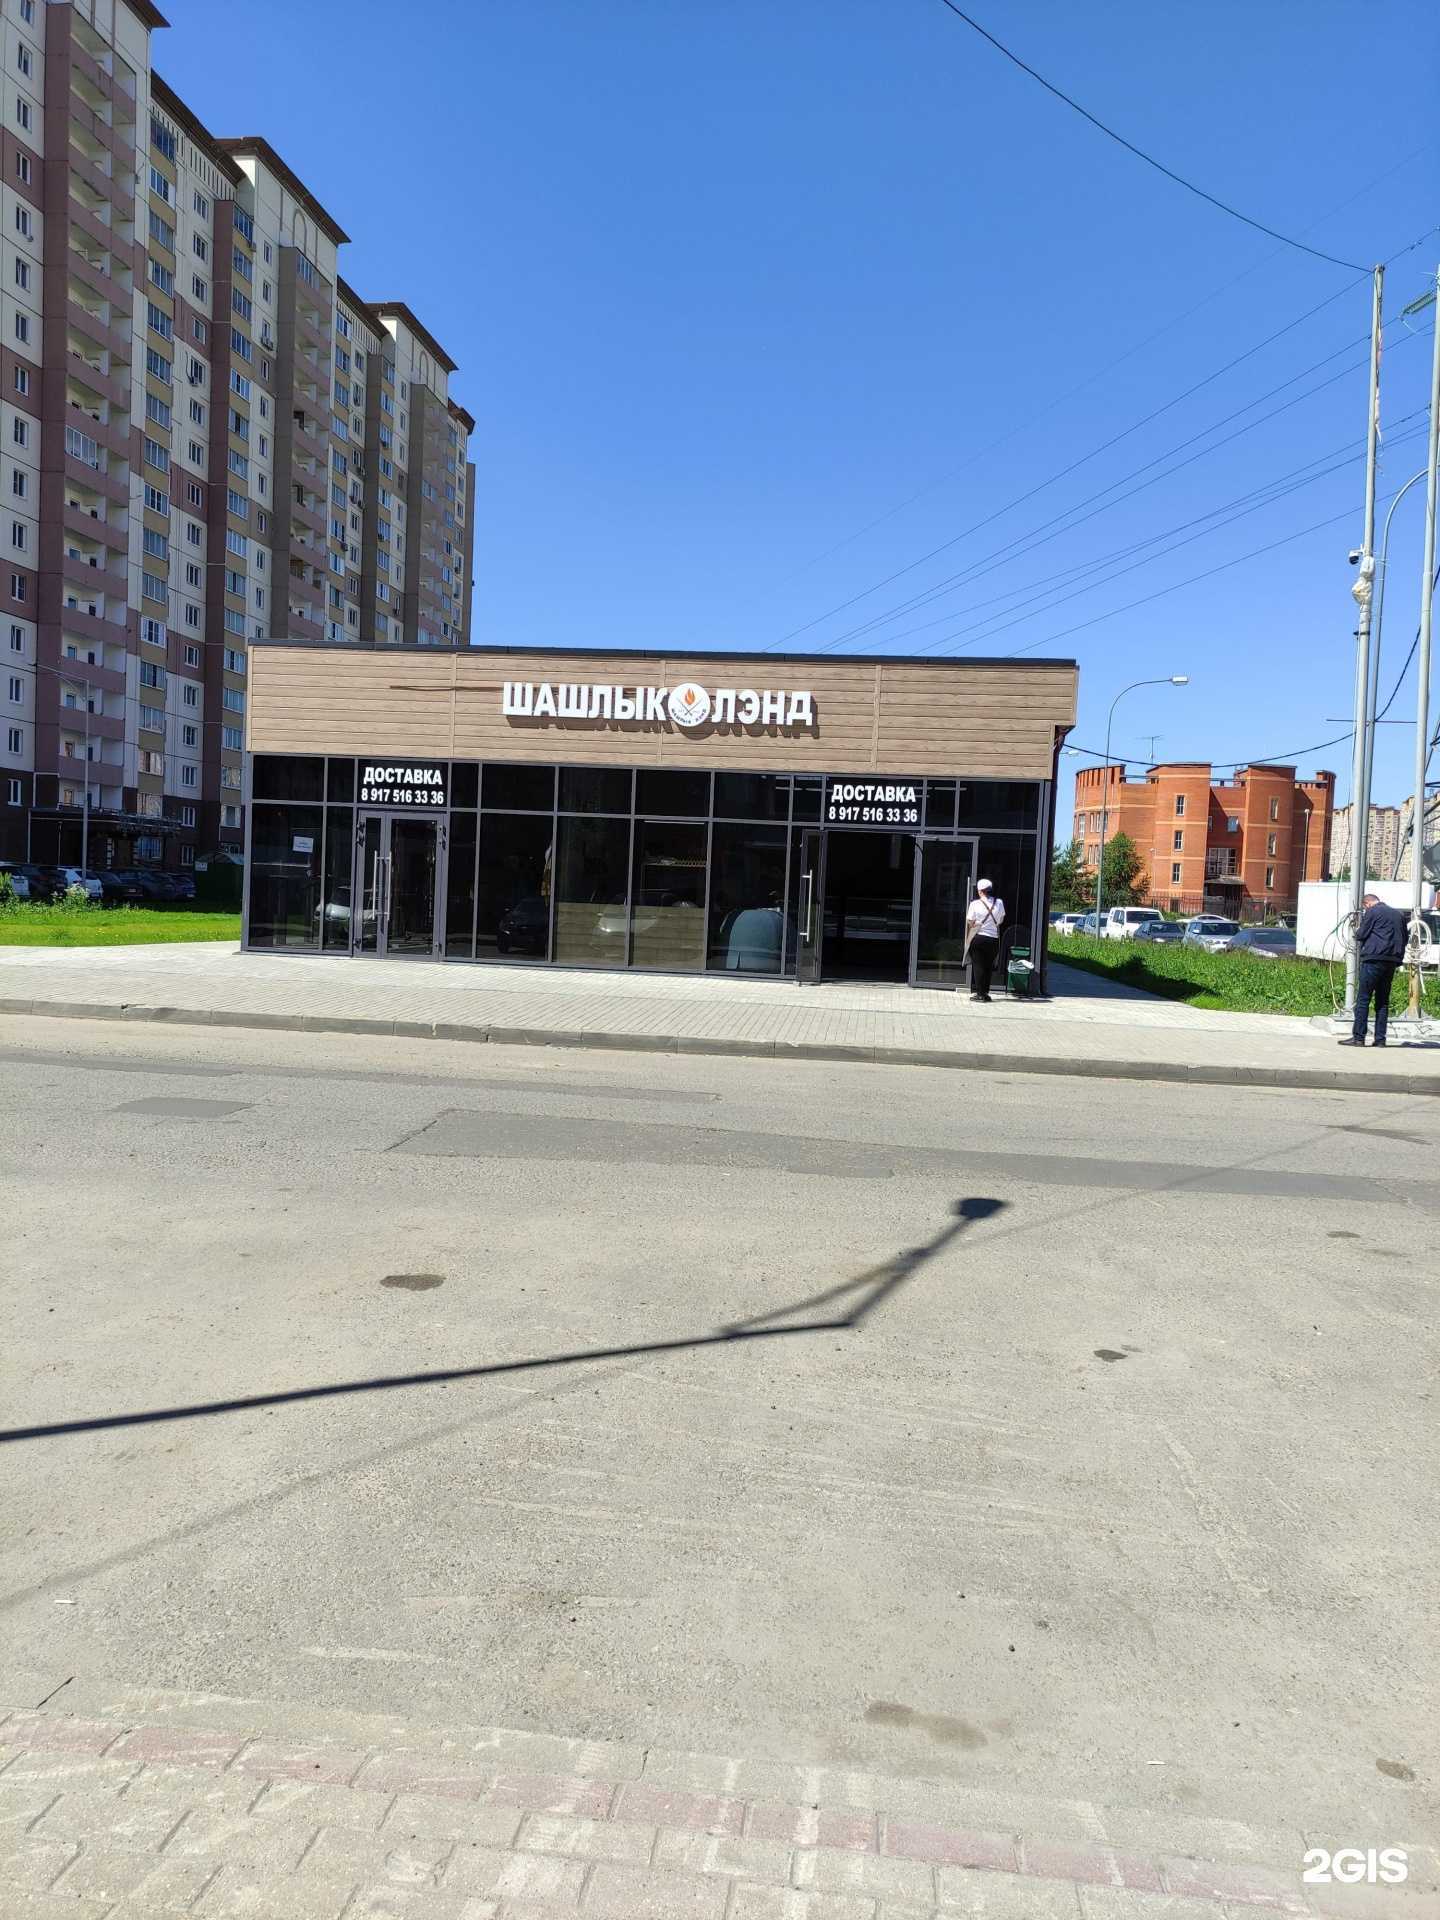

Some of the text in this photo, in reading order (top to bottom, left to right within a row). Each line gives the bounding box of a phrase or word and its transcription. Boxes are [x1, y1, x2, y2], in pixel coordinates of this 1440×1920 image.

[503, 681, 668, 721] ШАШЛЫК
[712, 688, 812, 726] ЛЭНД
[363, 766, 443, 785] ДОСТАВКА
[361, 788, 444, 804] 8 917 516 33 36
[831, 784, 917, 803] ДОСТАВКА
[828, 806, 918, 823] 8 917 516 33 36
